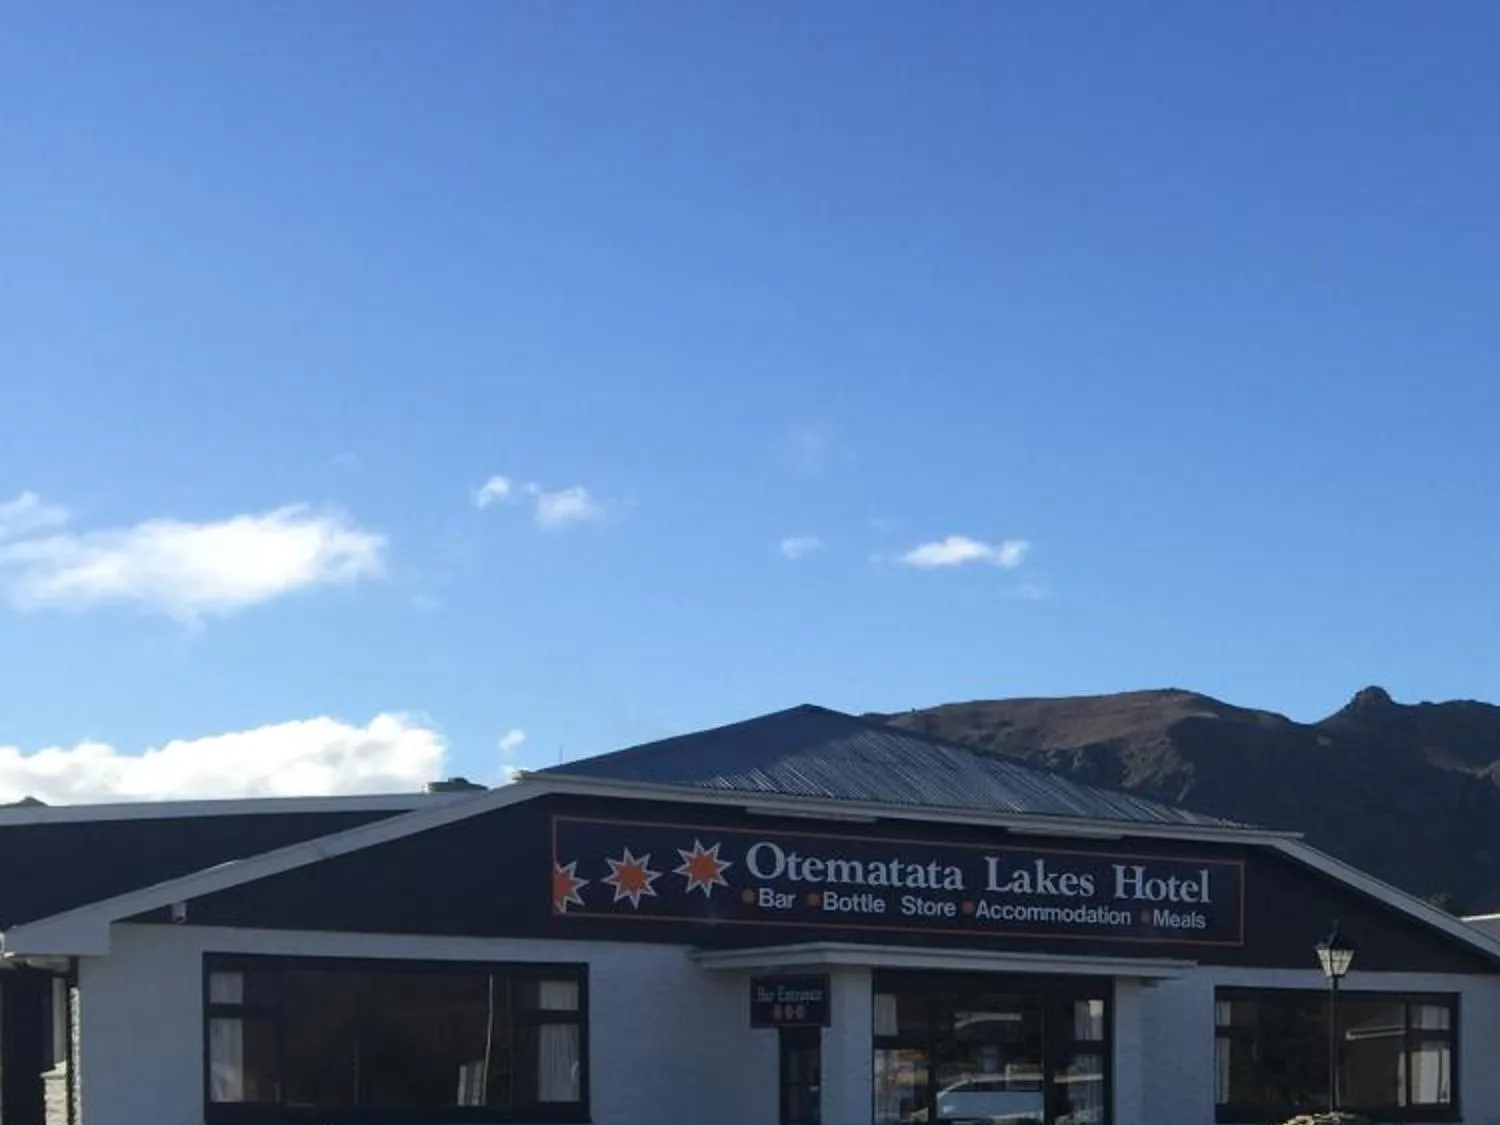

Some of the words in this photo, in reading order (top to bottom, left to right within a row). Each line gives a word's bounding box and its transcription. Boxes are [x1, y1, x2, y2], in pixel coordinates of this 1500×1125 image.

[746, 841, 965, 891] Otematata
[985, 857, 1096, 897] Lakes
[1113, 864, 1212, 904] Hotel
[759, 887, 796, 909] Bar
[823, 891, 887, 914] Bottle
[901, 895, 957, 917] Store
[976, 900, 1132, 926] Accommodation
[1153, 908, 1207, 930] Meals
